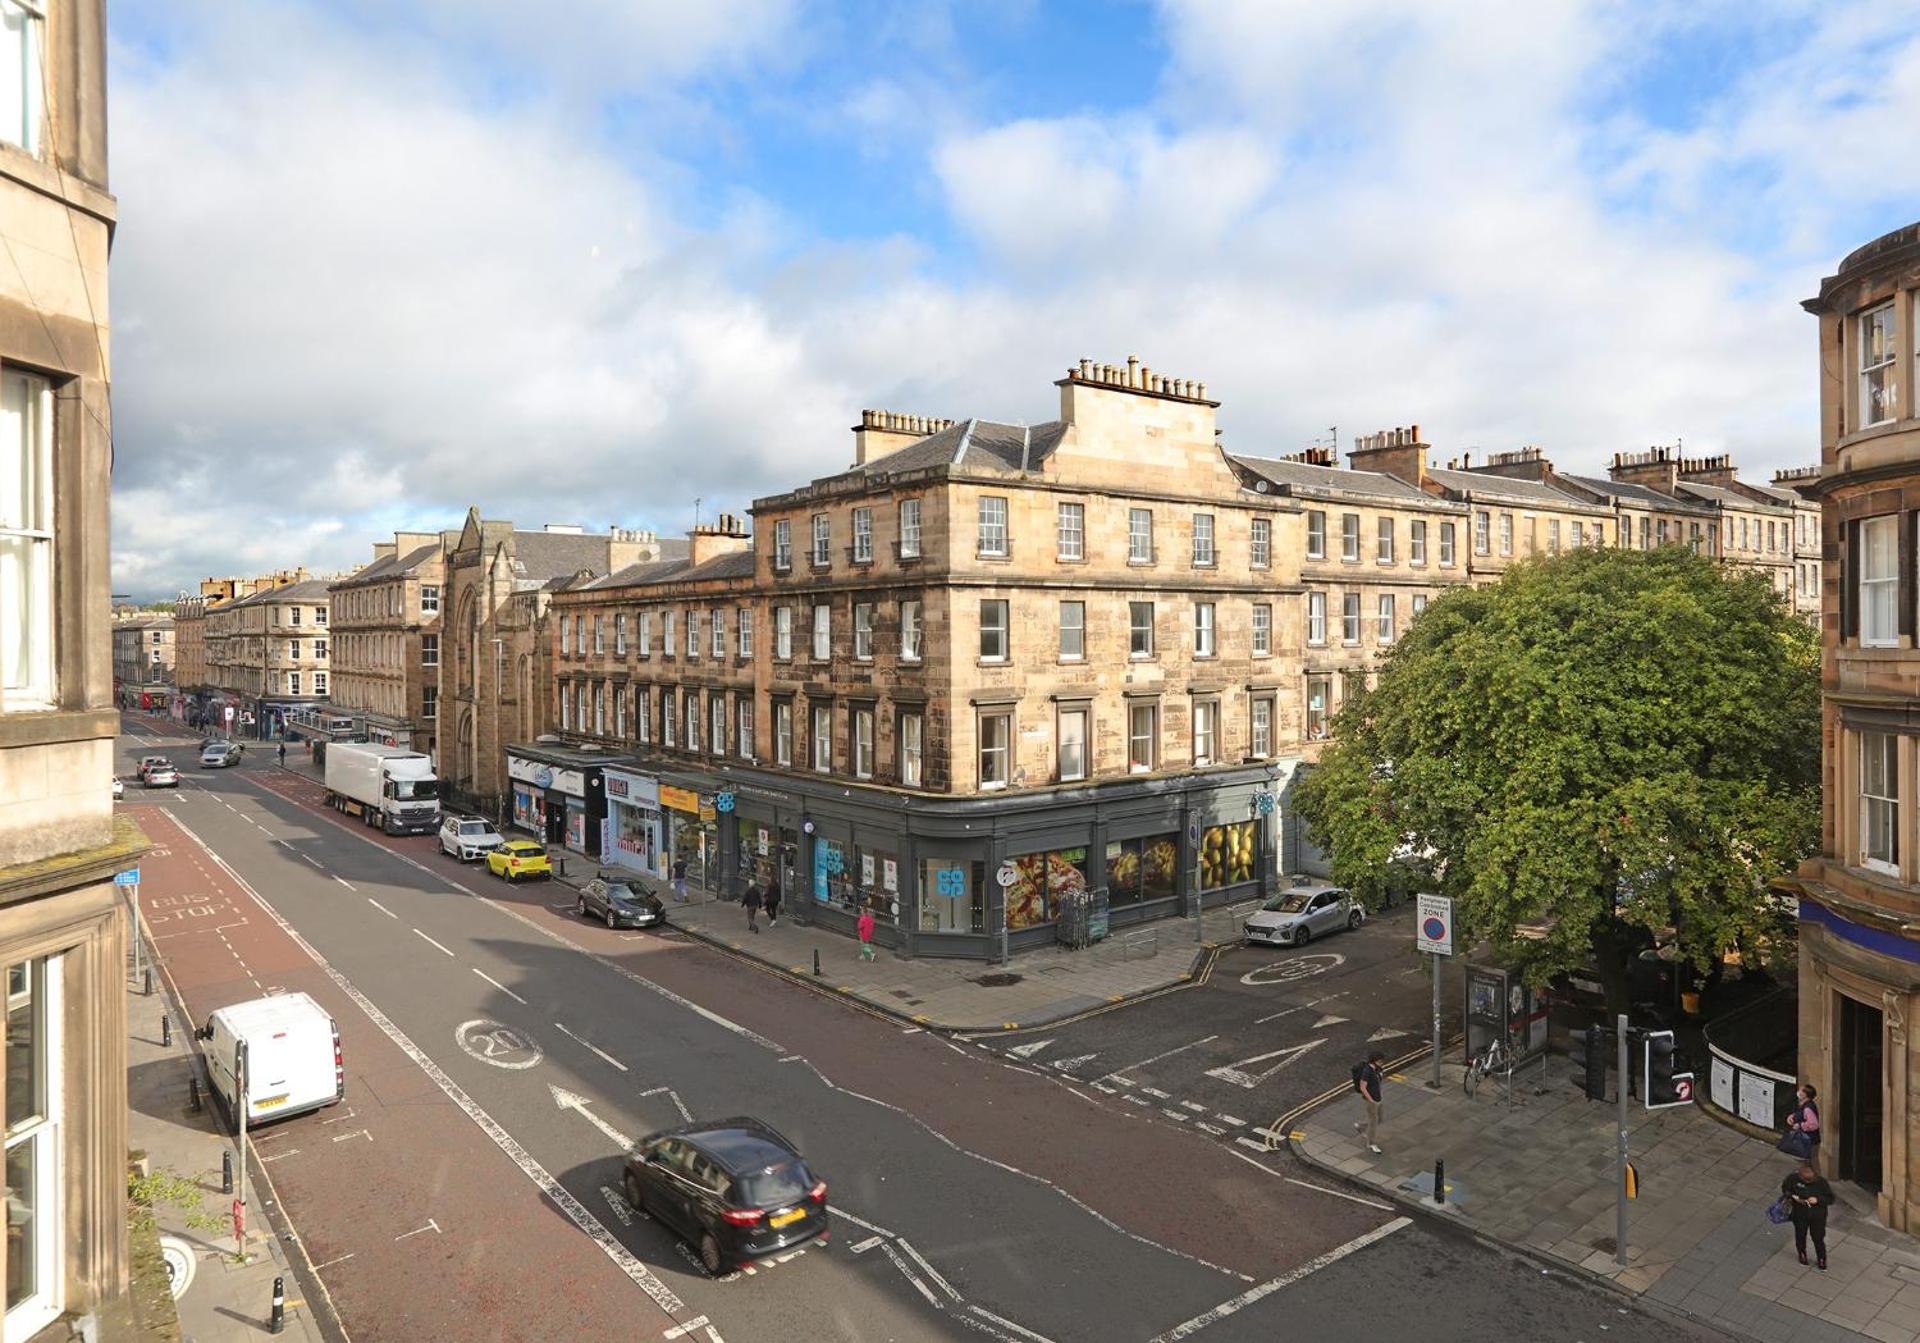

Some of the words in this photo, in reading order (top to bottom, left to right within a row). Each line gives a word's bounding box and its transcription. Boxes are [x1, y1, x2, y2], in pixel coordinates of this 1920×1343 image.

[151, 894, 210, 908] BUS
[148, 904, 224, 923] STOP
[1423, 908, 1444, 918] ZONE
[470, 1030, 522, 1057] 20
